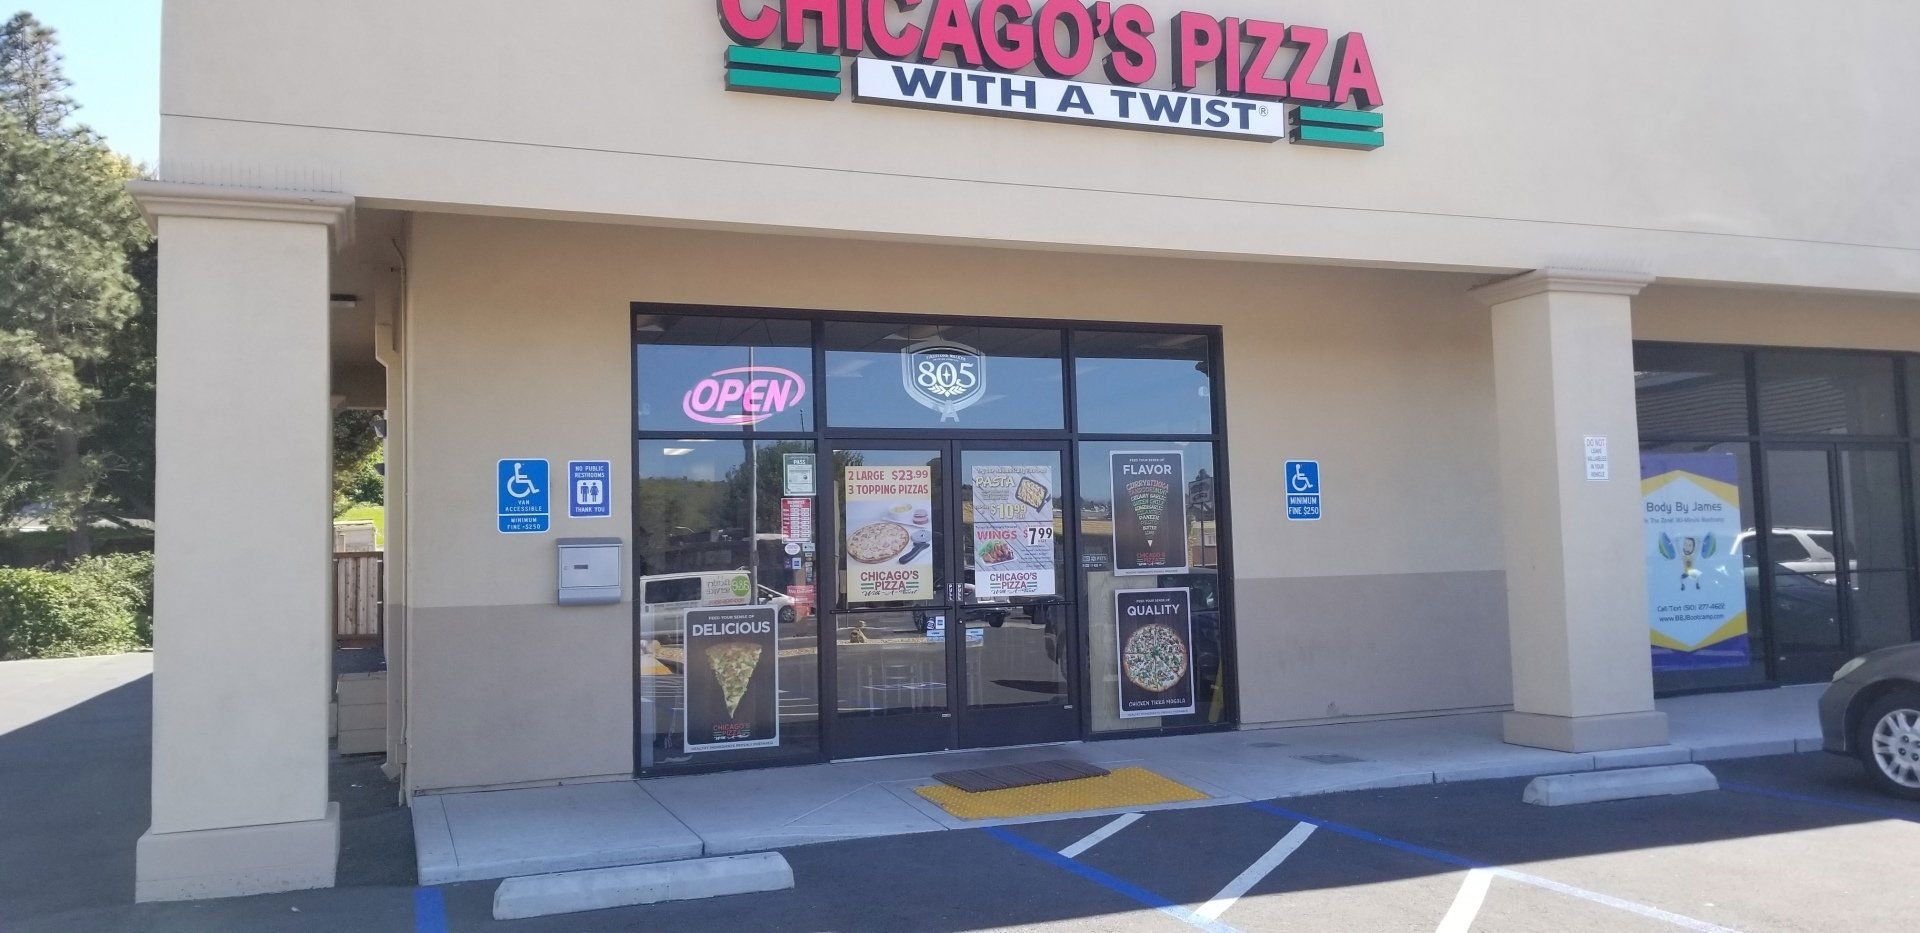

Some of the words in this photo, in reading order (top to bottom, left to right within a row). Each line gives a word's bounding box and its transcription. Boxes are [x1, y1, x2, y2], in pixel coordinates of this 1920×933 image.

[1175, 10, 1383, 107] PIZZA
[891, 65, 1036, 102] WITH
[1055, 84, 1096, 116] A
[917, 361, 976, 388] 805
[690, 378, 792, 413] OPEN
[1123, 464, 1172, 474] FLAVOR
[848, 471, 854, 480] 2
[857, 470, 884, 480] LARGE
[892, 470, 928, 480] $23.99
[976, 476, 1015, 488] PASTA
[848, 486, 854, 494] 3
[856, 485, 896, 494] TOPPING
[899, 484, 928, 494] PIZZAS
[1303, 506, 1318, 515] $250
[1646, 502, 1672, 514] Body
[1676, 502, 1689, 513] By
[1692, 502, 1722, 511] James
[977, 530, 1017, 540] WINGS
[861, 570, 919, 581] CHICAGO'S
[990, 572, 1037, 581] CHICAGO'S
[875, 581, 907, 590] PIZZA
[1001, 581, 1027, 590] PIZZA
[1127, 604, 1179, 616] QUALITY
[692, 621, 770, 636] DELICIOUS
